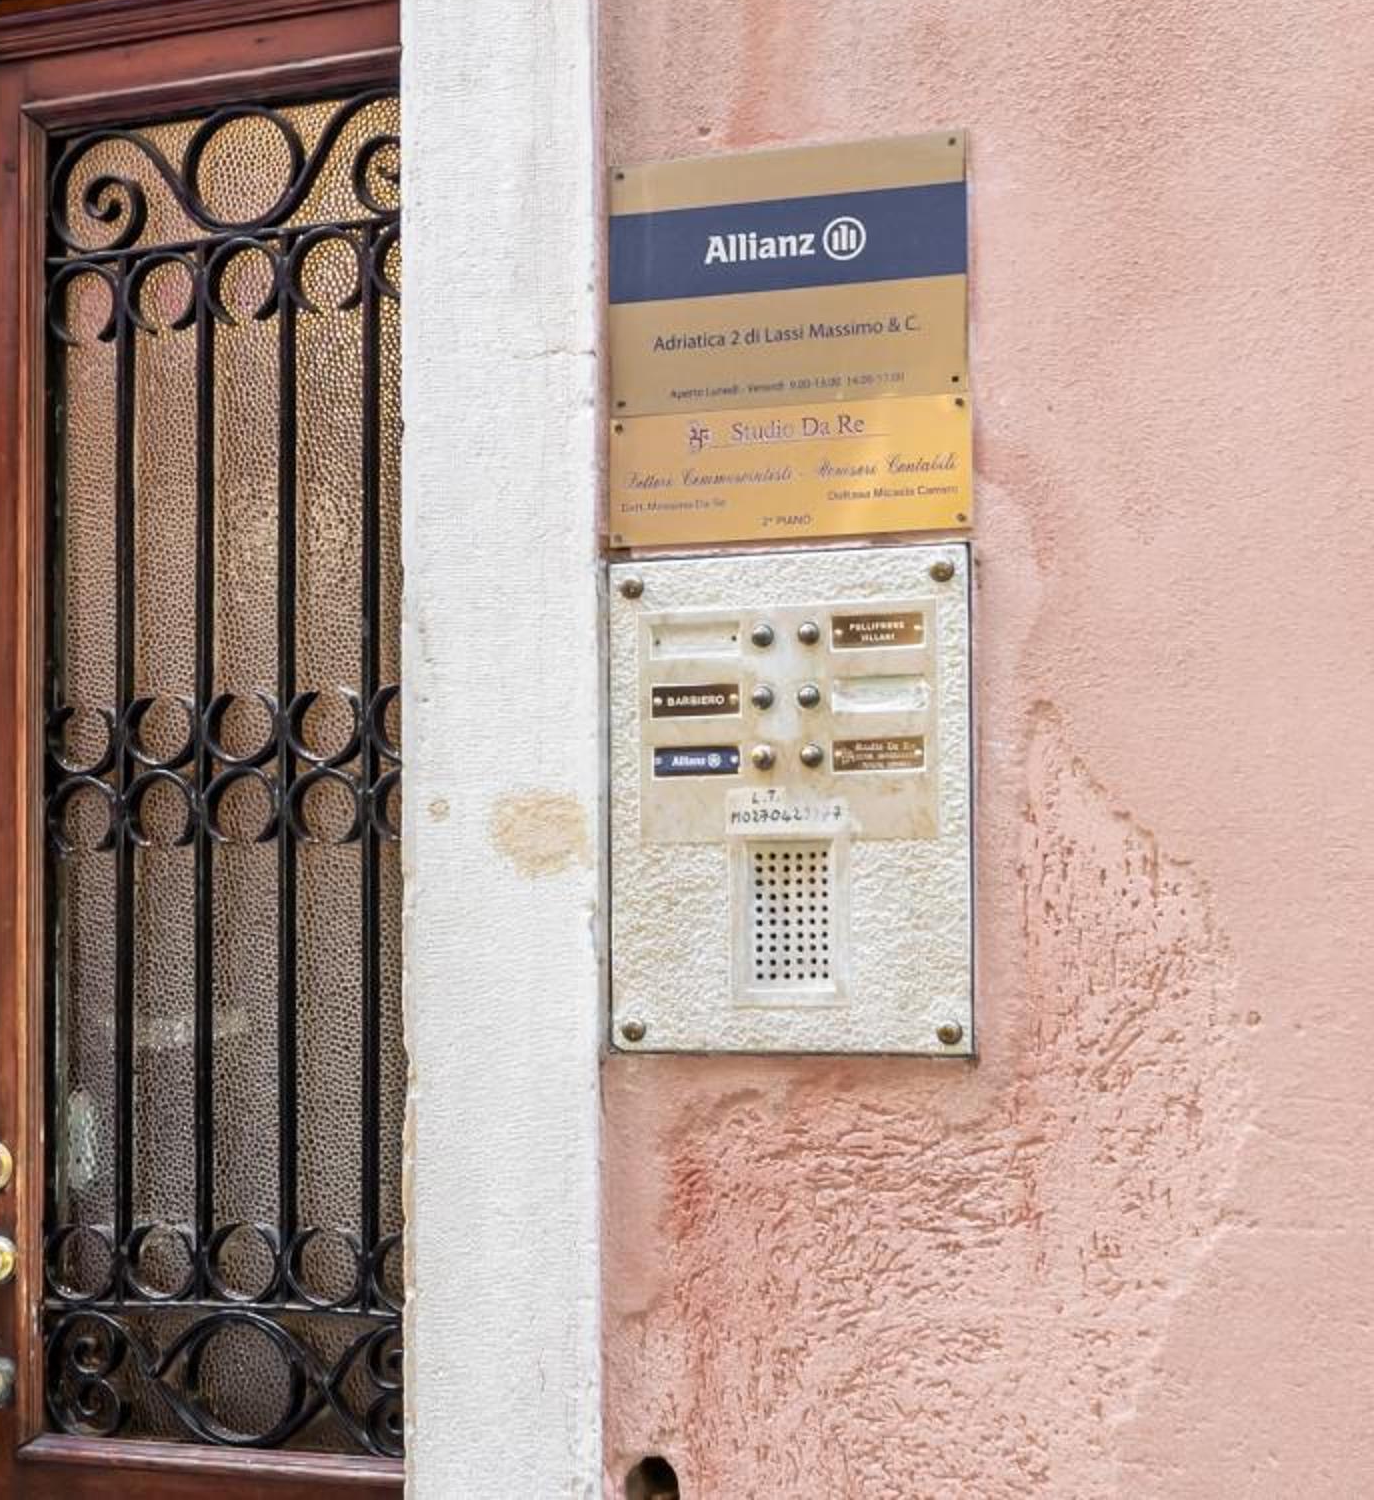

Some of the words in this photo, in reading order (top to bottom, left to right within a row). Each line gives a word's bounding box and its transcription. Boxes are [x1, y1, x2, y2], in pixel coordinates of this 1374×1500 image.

[704, 232, 816, 265] Allianz
[653, 332, 726, 352] Adriatica
[731, 330, 741, 346] 2
[744, 327, 761, 344] di
[765, 324, 805, 343] Lassi
[809, 319, 884, 339] Massimo
[889, 316, 901, 333] &
[731, 419, 794, 442] Studio
[801, 416, 831, 437] Da
[837, 414, 866, 435] Re
[776, 514, 812, 526] PIANO
[667, 694, 725, 708] BARBIERO
[671, 754, 706, 767] Allianz
